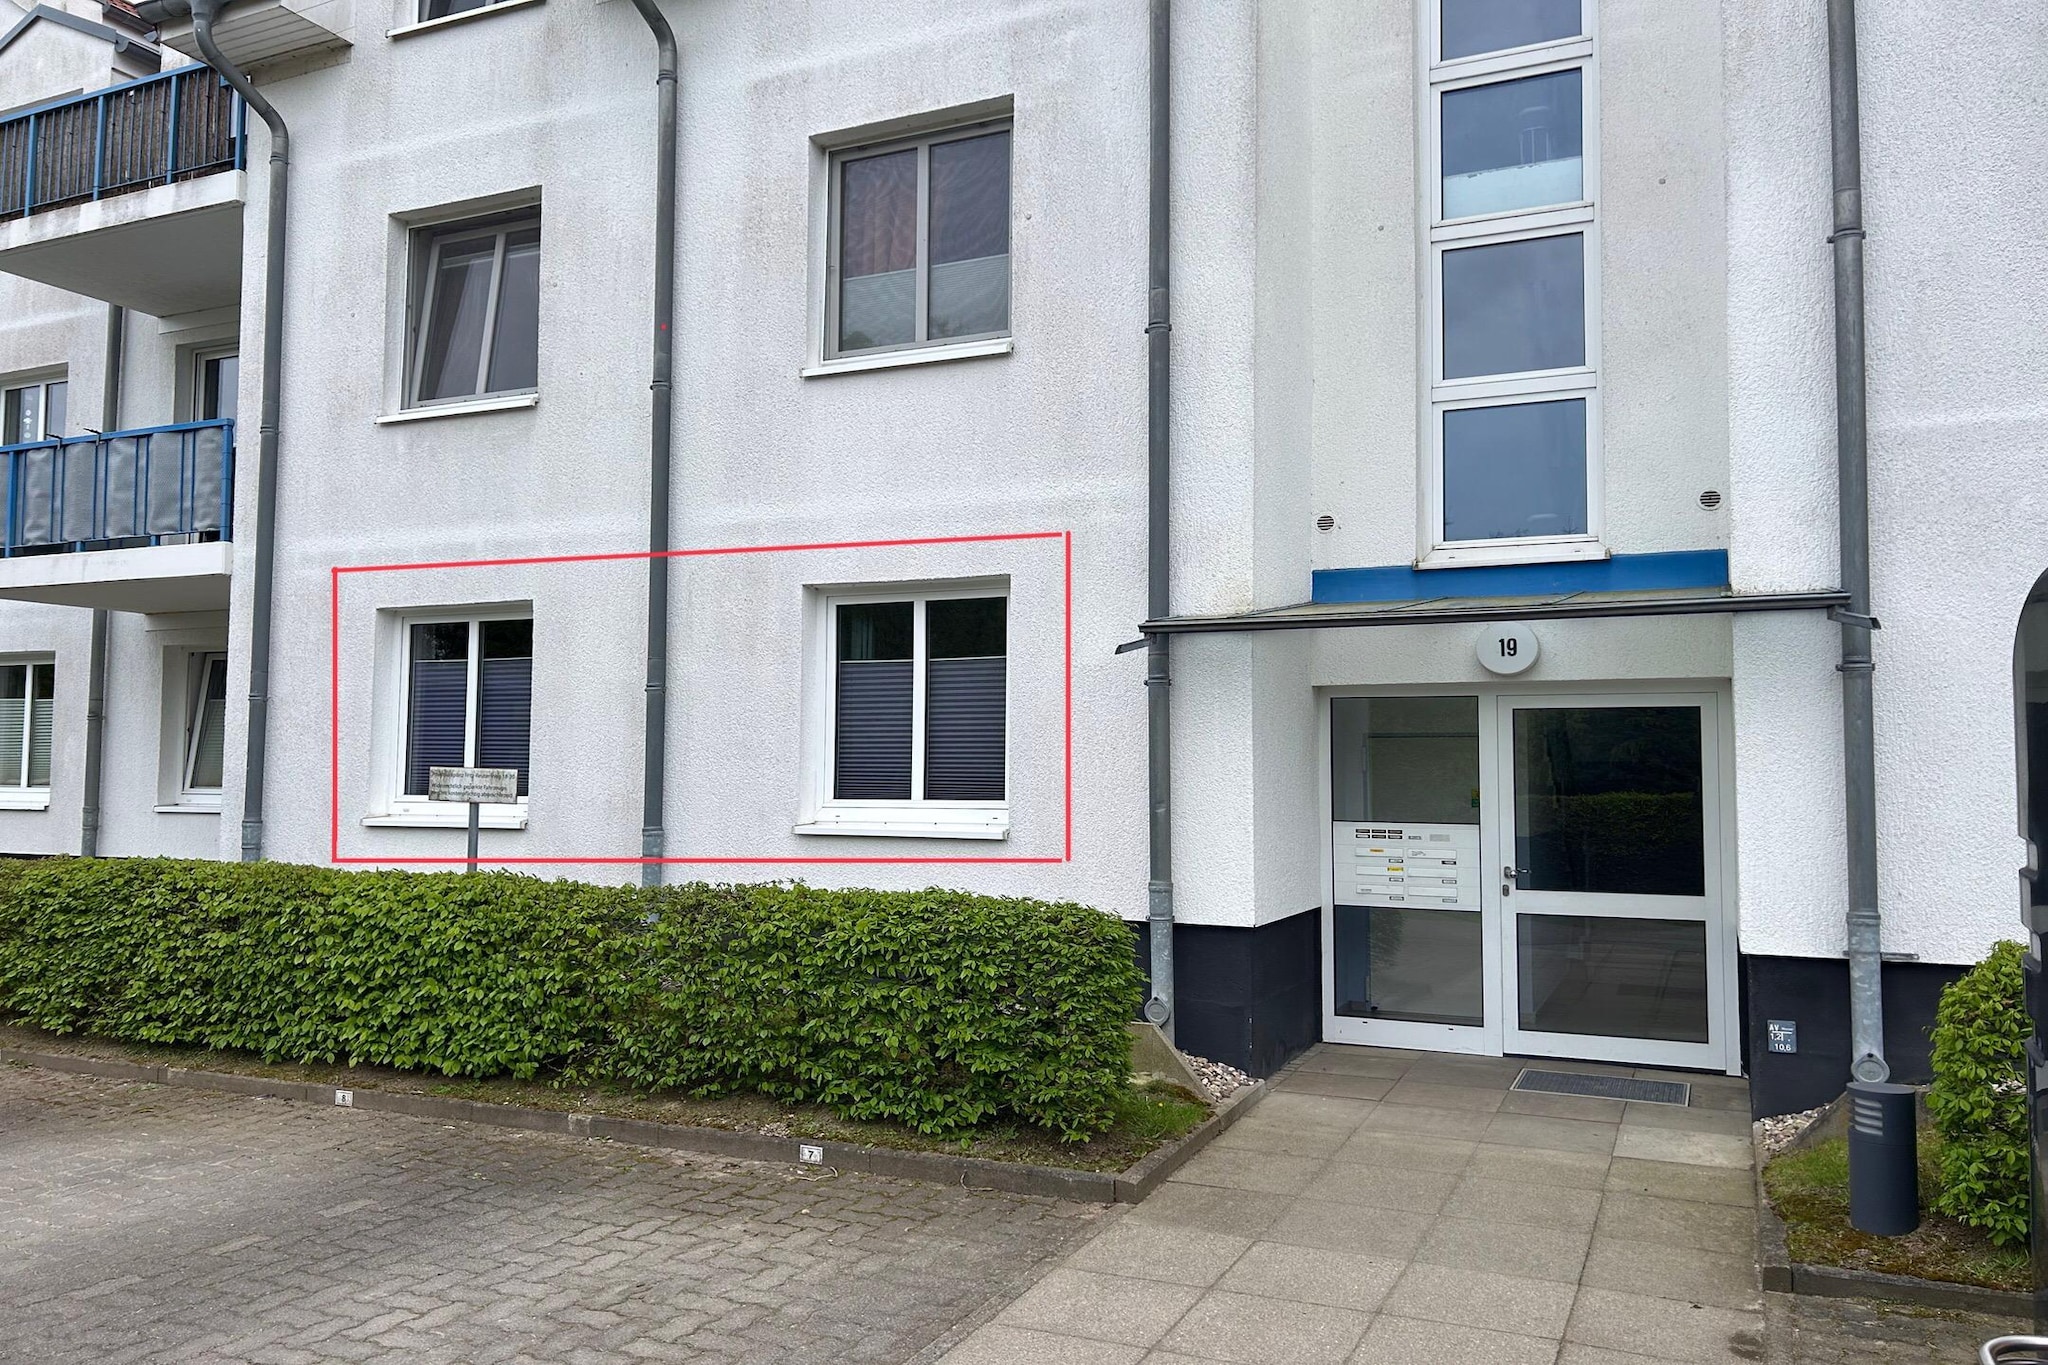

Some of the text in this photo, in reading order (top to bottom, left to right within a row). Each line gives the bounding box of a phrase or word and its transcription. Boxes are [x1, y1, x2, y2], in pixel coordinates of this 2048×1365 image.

[1498, 638, 1517, 657] 19
[341, 1094, 347, 1103] 8
[808, 1150, 815, 1160] 7
